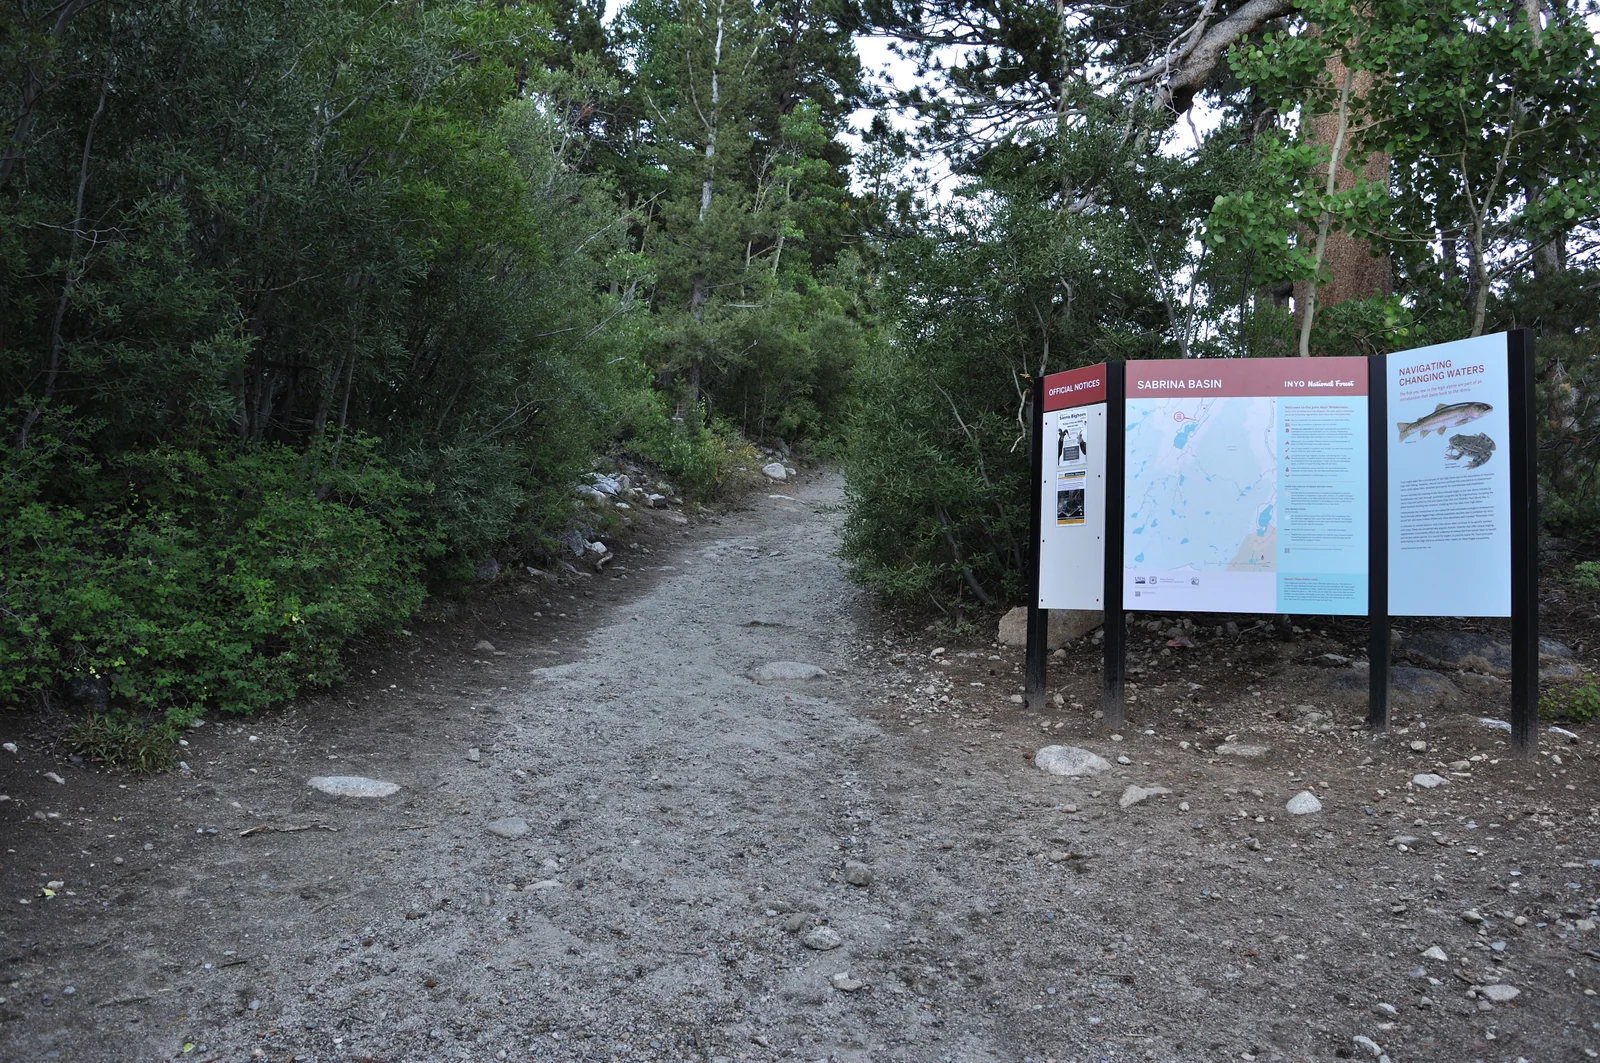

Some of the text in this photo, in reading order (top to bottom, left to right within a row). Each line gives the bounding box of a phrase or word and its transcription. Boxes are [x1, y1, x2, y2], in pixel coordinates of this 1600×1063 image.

[1399, 359, 1452, 376] NAVIGATING
[1399, 364, 1485, 387] CHANGING WATERS
[1048, 379, 1101, 396] OFFICIAL NOTICES
[1137, 379, 1222, 390] SABRINA BASIN
[1284, 380, 1305, 388] INYO
[1335, 379, 1354, 387] Forest
